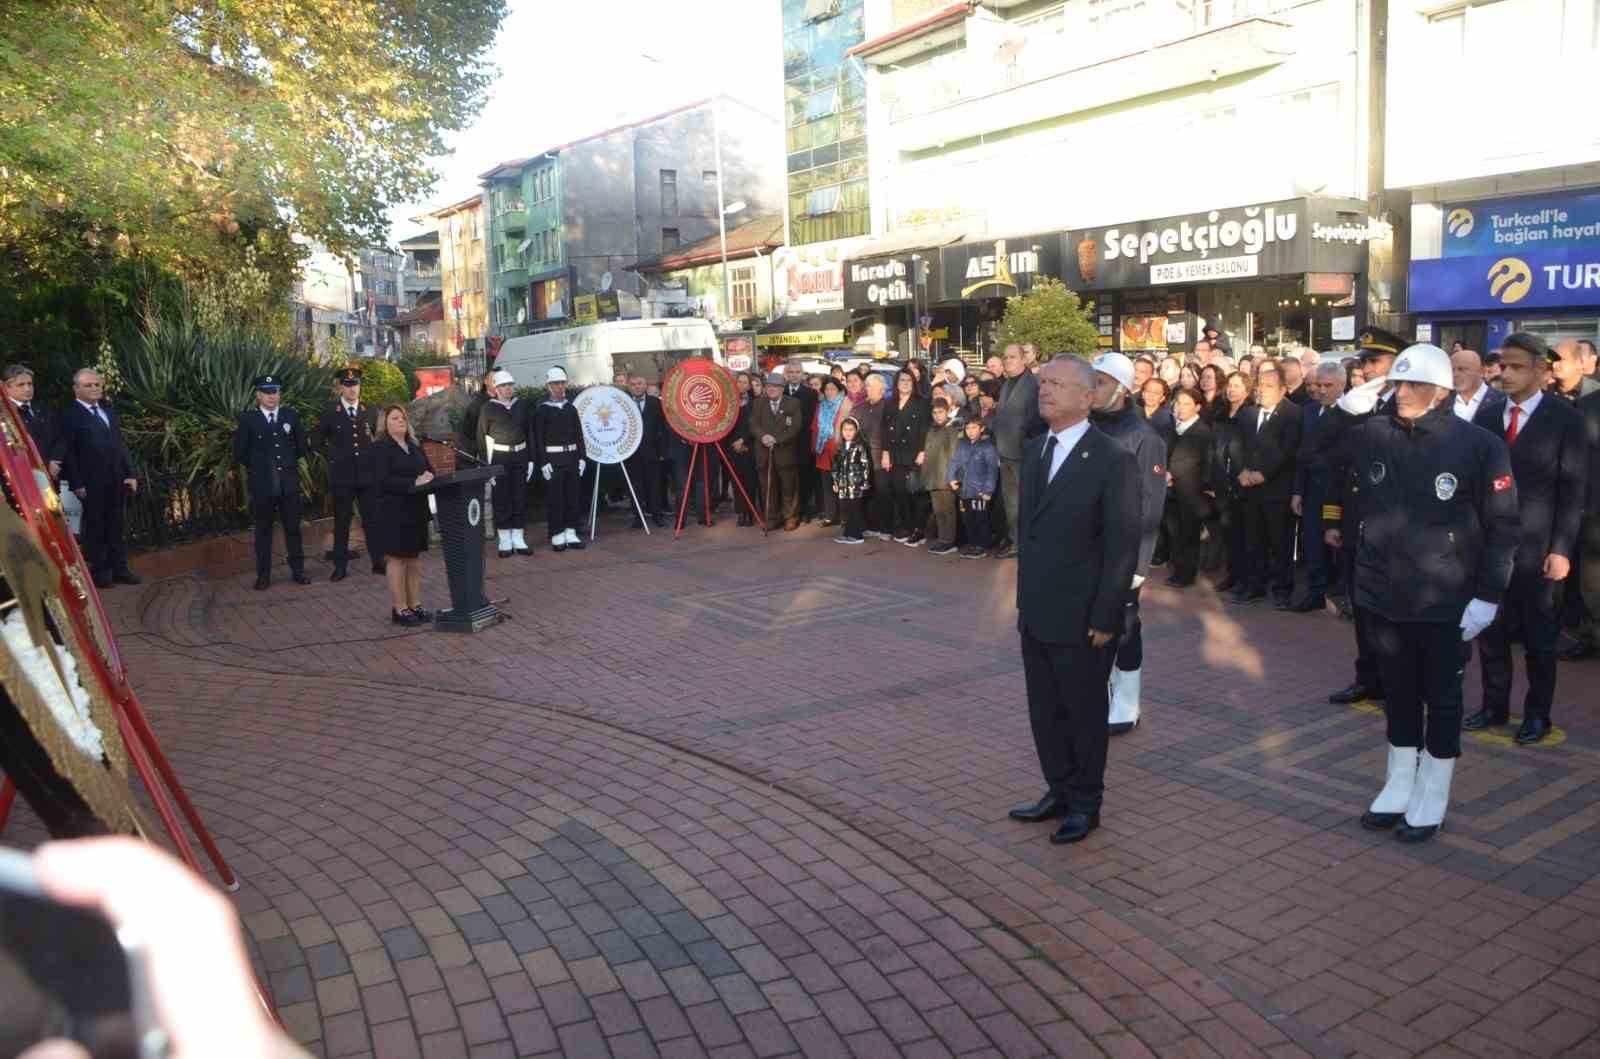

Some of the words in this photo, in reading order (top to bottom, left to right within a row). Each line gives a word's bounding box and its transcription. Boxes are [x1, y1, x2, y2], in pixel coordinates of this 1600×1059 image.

[1491, 208, 1568, 228] Turkcell'le
[1104, 207, 1297, 265] Sepetçioğlu
[1495, 227, 1549, 244] bağlan
[1186, 263, 1213, 277] YEMEK
[1215, 259, 1249, 275] SALONU
